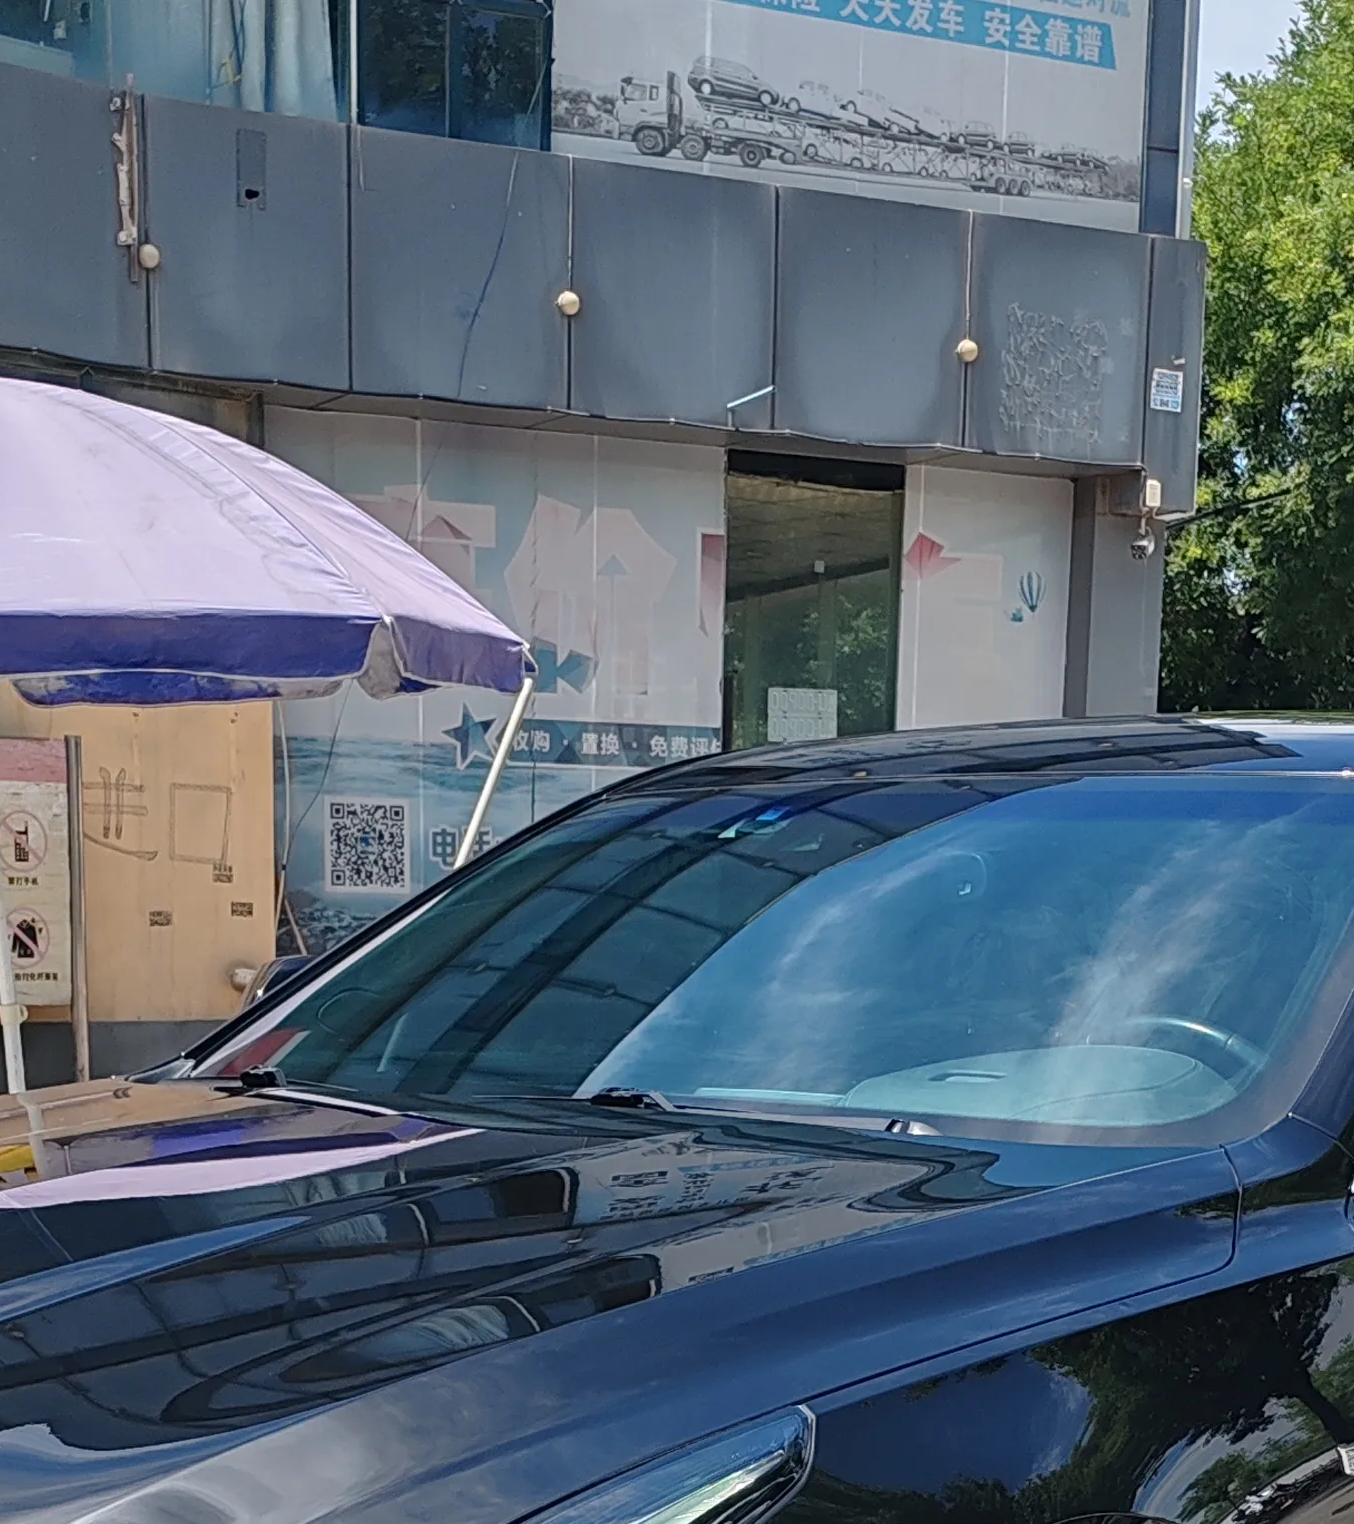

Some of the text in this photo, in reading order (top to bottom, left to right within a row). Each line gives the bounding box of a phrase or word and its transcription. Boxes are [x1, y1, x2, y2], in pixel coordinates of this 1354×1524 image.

[983, 8, 1103, 63] 安全靠谱
[581, 732, 620, 755] 置换
